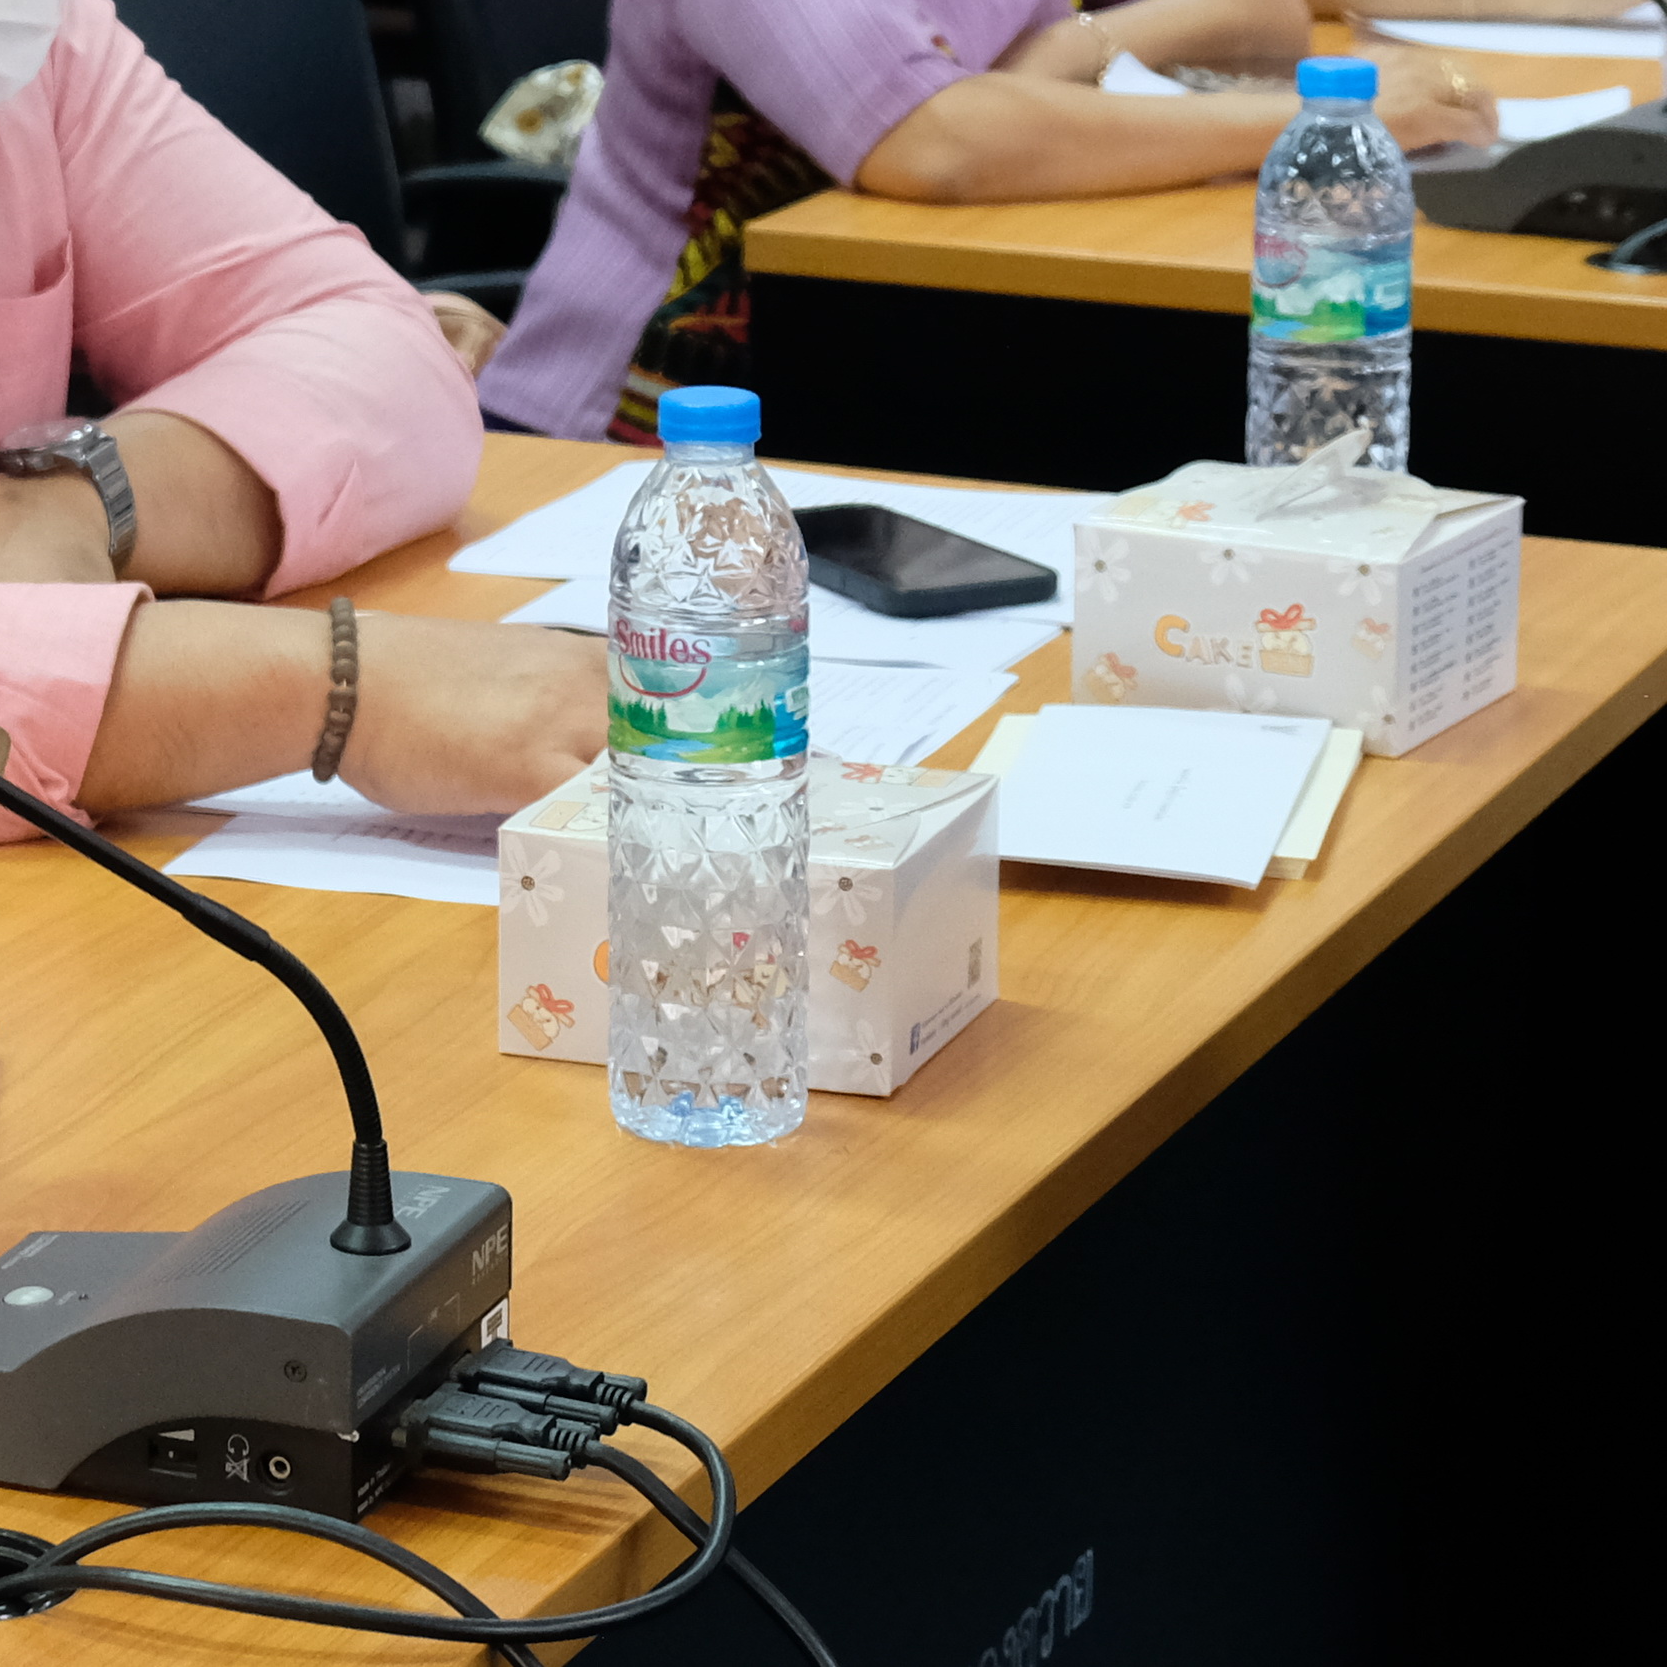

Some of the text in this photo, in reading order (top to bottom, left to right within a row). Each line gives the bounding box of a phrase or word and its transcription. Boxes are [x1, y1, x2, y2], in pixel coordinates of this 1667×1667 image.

[616, 618, 712, 665] Smiles
[1154, 613, 1254, 669] CAKE
[472, 1223, 509, 1279] NPE
